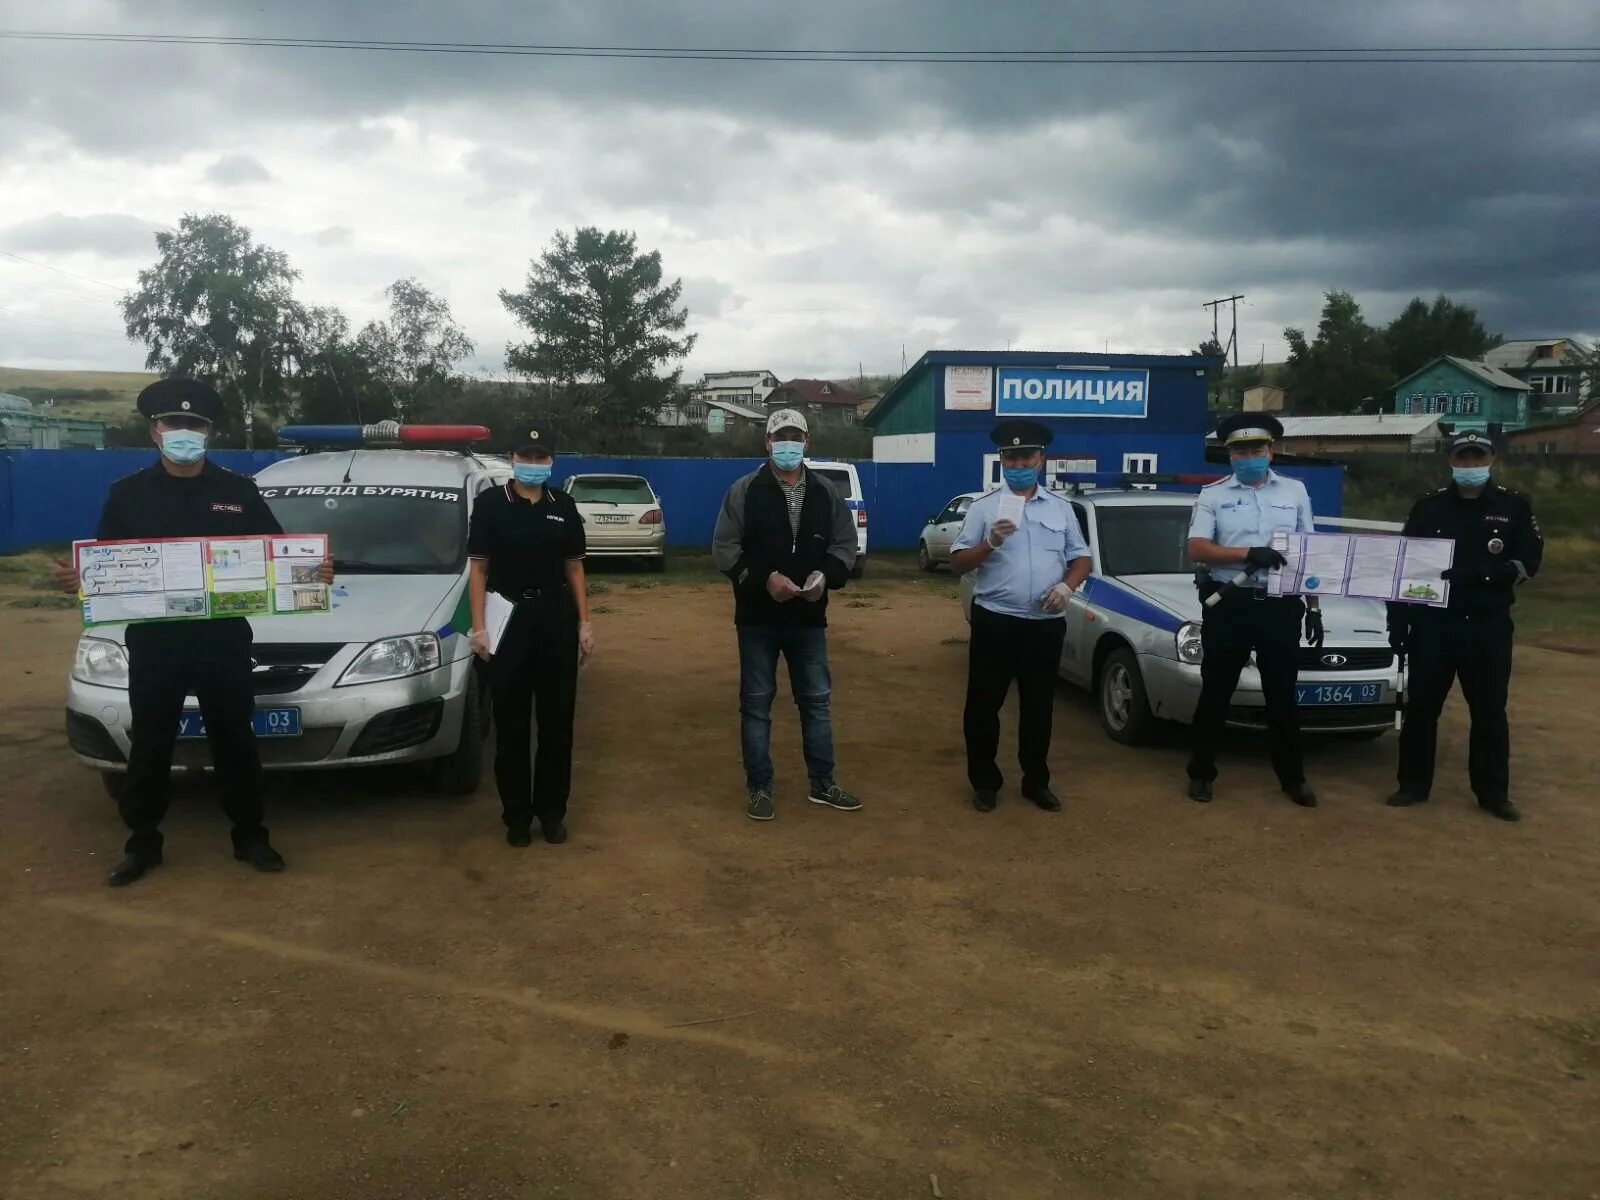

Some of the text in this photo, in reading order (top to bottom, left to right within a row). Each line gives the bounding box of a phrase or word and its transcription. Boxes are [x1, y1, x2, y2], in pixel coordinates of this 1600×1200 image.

[1003, 378, 1144, 404] ПОЛИЦИЯ
[284, 486, 358, 496] ГИБДД
[362, 486, 459, 502] БУРЯТИЯ
[1315, 686, 1352, 702] 1364
[1362, 685, 1376, 697] 03
[268, 711, 290, 727] 03
